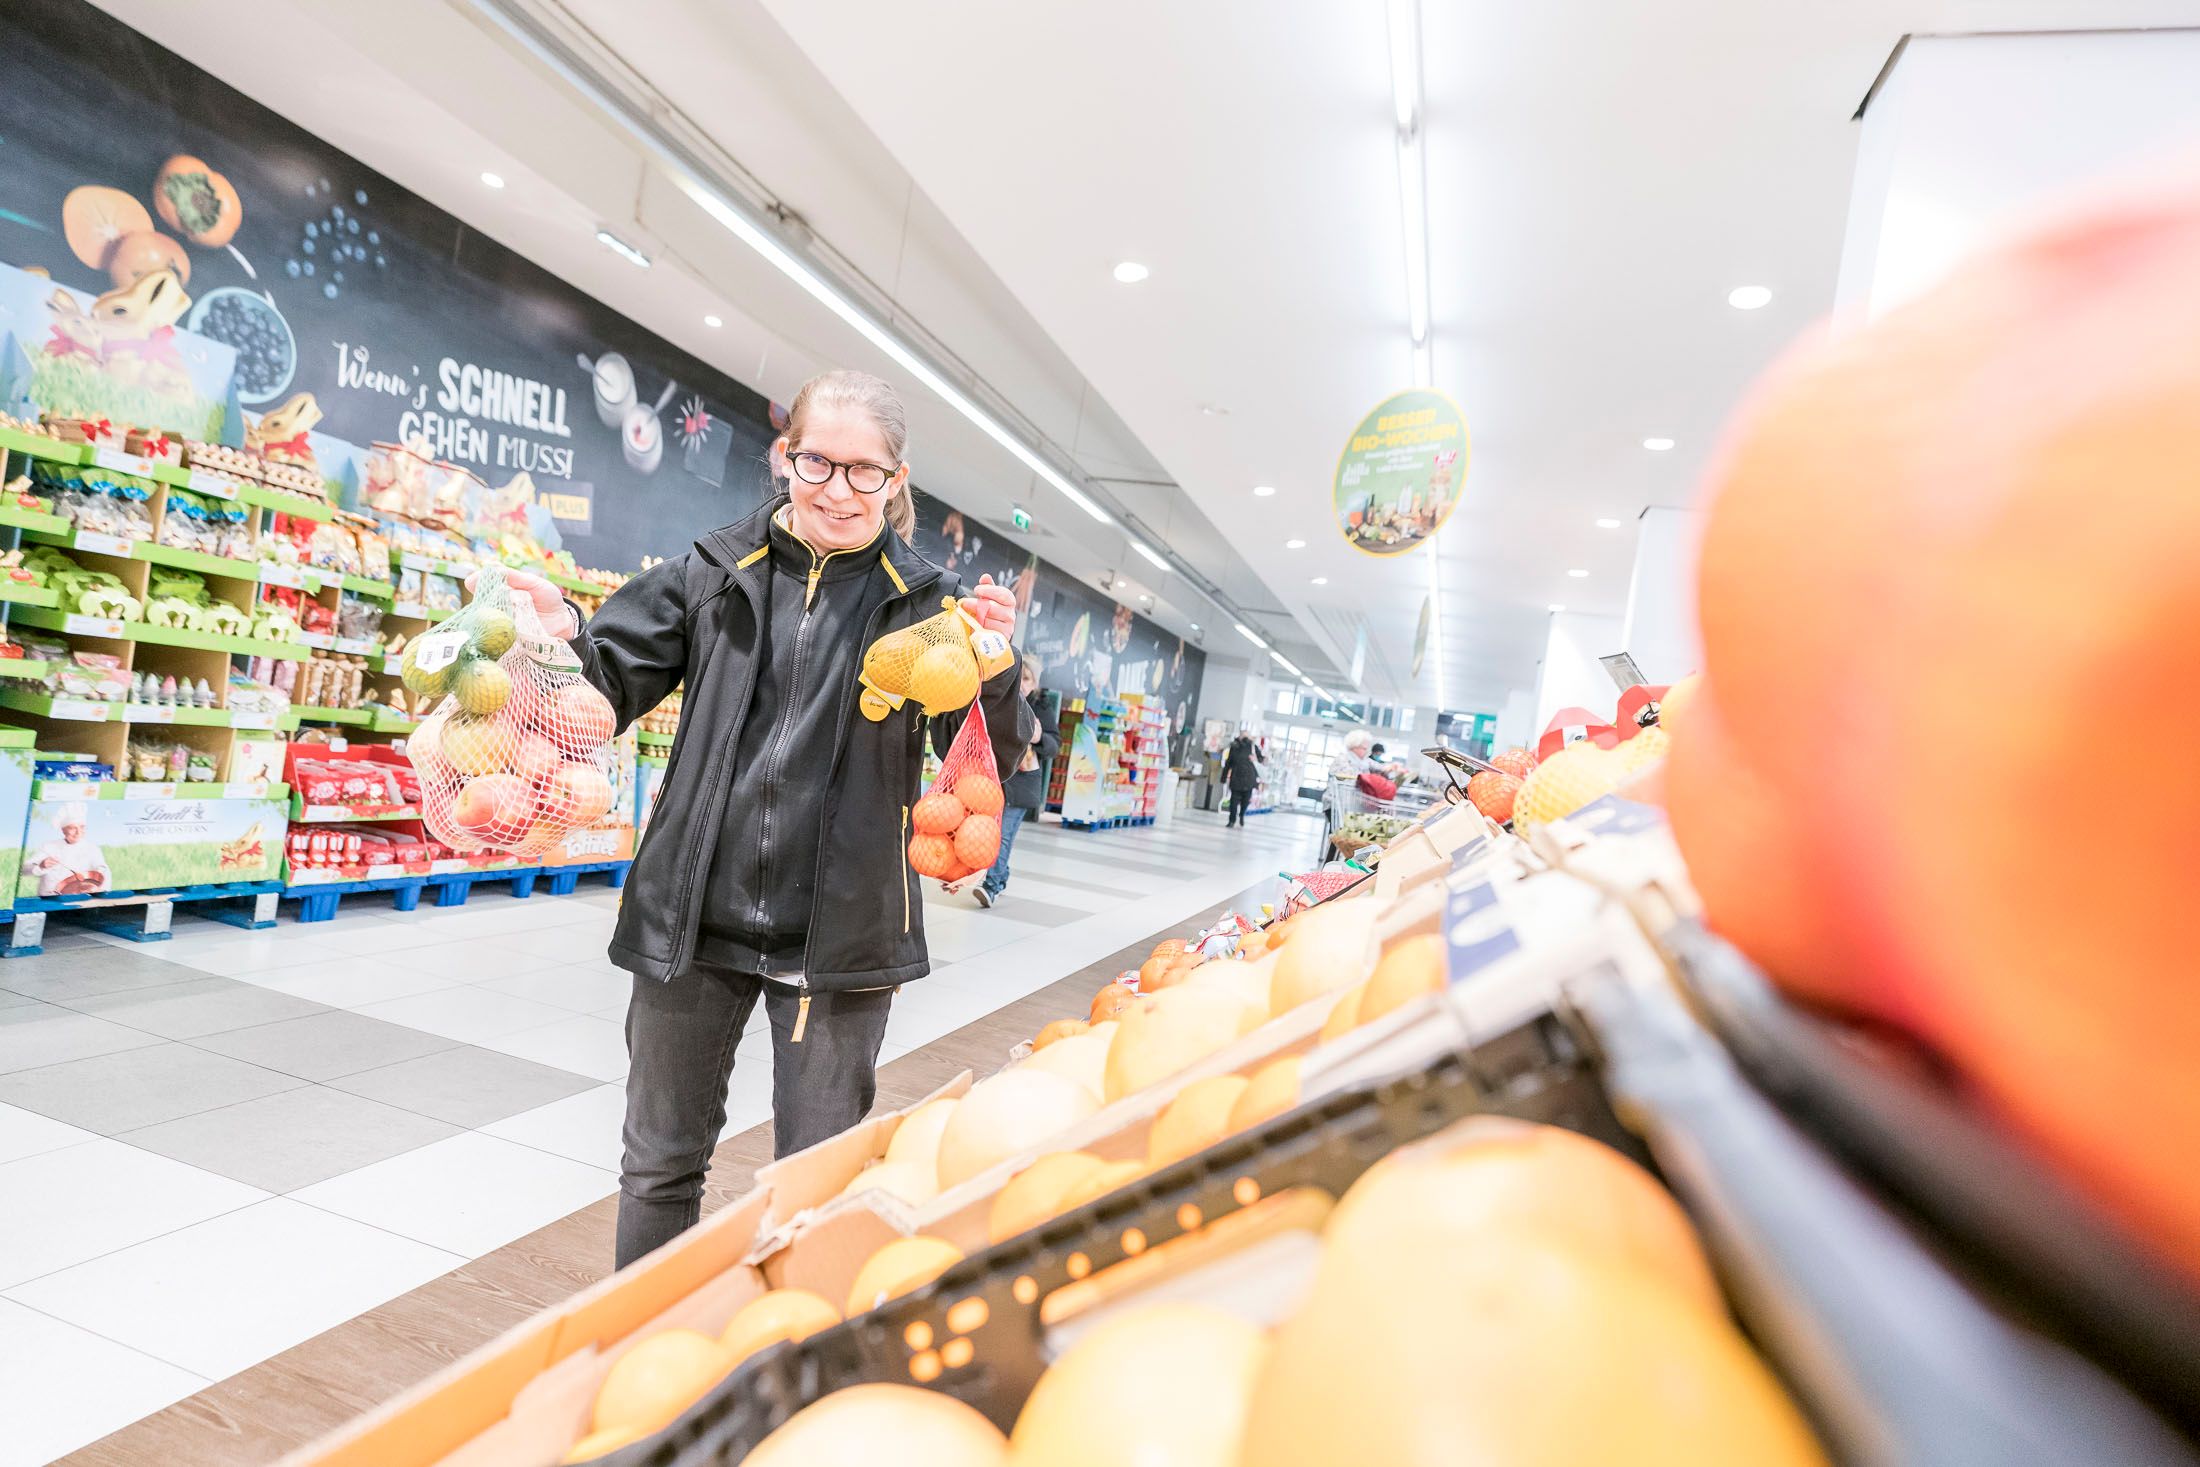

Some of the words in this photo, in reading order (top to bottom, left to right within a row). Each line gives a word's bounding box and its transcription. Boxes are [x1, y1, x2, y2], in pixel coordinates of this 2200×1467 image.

[437, 357, 571, 438] SCHNELL
[398, 411, 489, 465] GEHEN
[496, 434, 574, 480] MUSS!
[136, 803, 193, 821] Lindt
